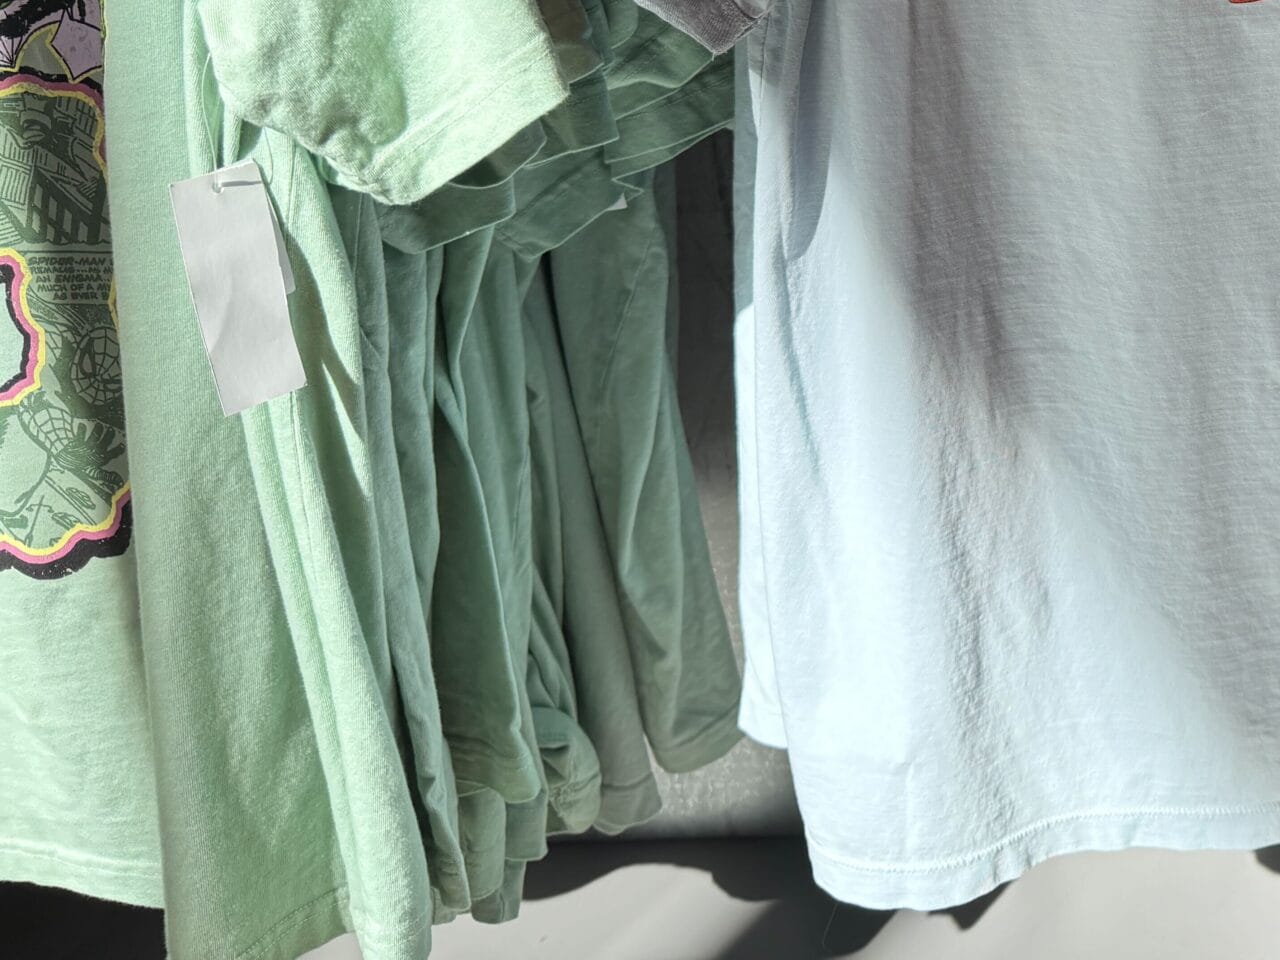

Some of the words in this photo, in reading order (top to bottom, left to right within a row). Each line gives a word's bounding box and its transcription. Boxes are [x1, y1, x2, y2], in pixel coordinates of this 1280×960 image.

[28, 256, 105, 267] SPIDER-MAN
[37, 283, 68, 293] MUCH
[70, 283, 84, 292] OF
[86, 283, 95, 292] A
[53, 291, 68, 301] AS
[70, 291, 98, 300] EVER
